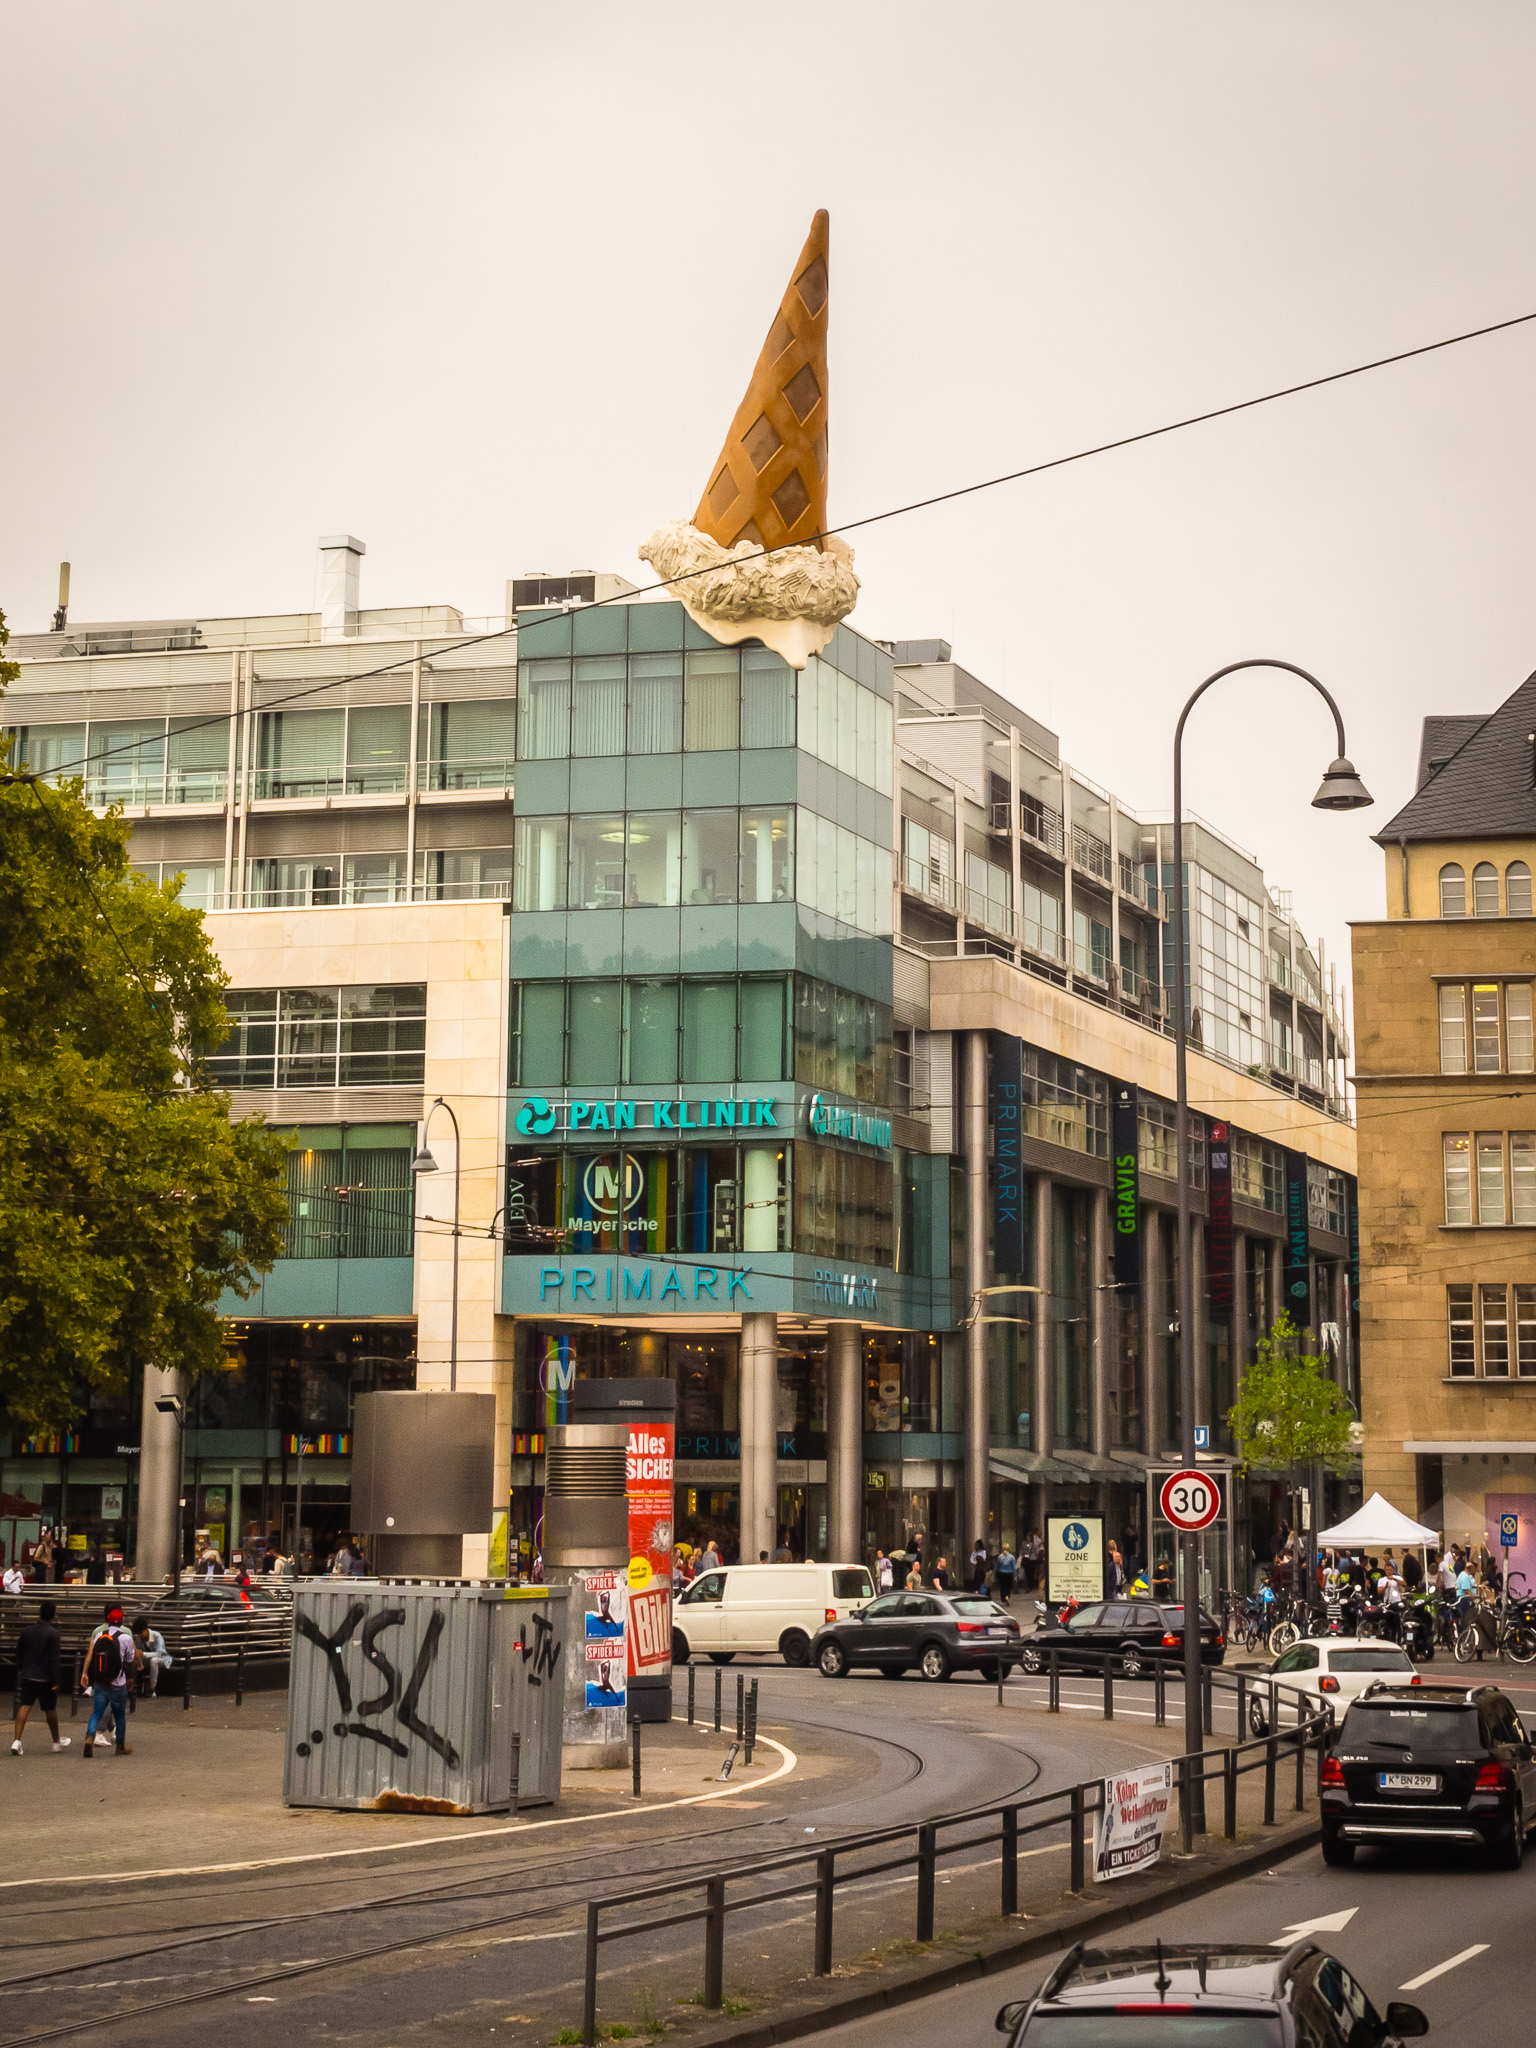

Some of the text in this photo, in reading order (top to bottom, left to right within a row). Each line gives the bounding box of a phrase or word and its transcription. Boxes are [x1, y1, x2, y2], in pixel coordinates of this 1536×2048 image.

[570, 1097, 778, 1131] PAN KLINIK
[999, 1083, 1018, 1223] PRIMARK
[1116, 1154, 1137, 1235] GRAVIS
[568, 1216, 659, 1234] Mayersche
[1290, 1182, 1306, 1268] PAN KLINIK
[541, 1266, 754, 1301] PRIMARK
[813, 1268, 879, 1310] PRIMARK
[626, 1432, 666, 1455] Alles
[677, 1436, 798, 1456] PRIMK
[1173, 1487, 1207, 1514] 30
[1501, 1536, 1516, 1544] TAXI
[1064, 1552, 1089, 1562] ZONE
[1388, 1776, 1432, 1786] K BN 299
